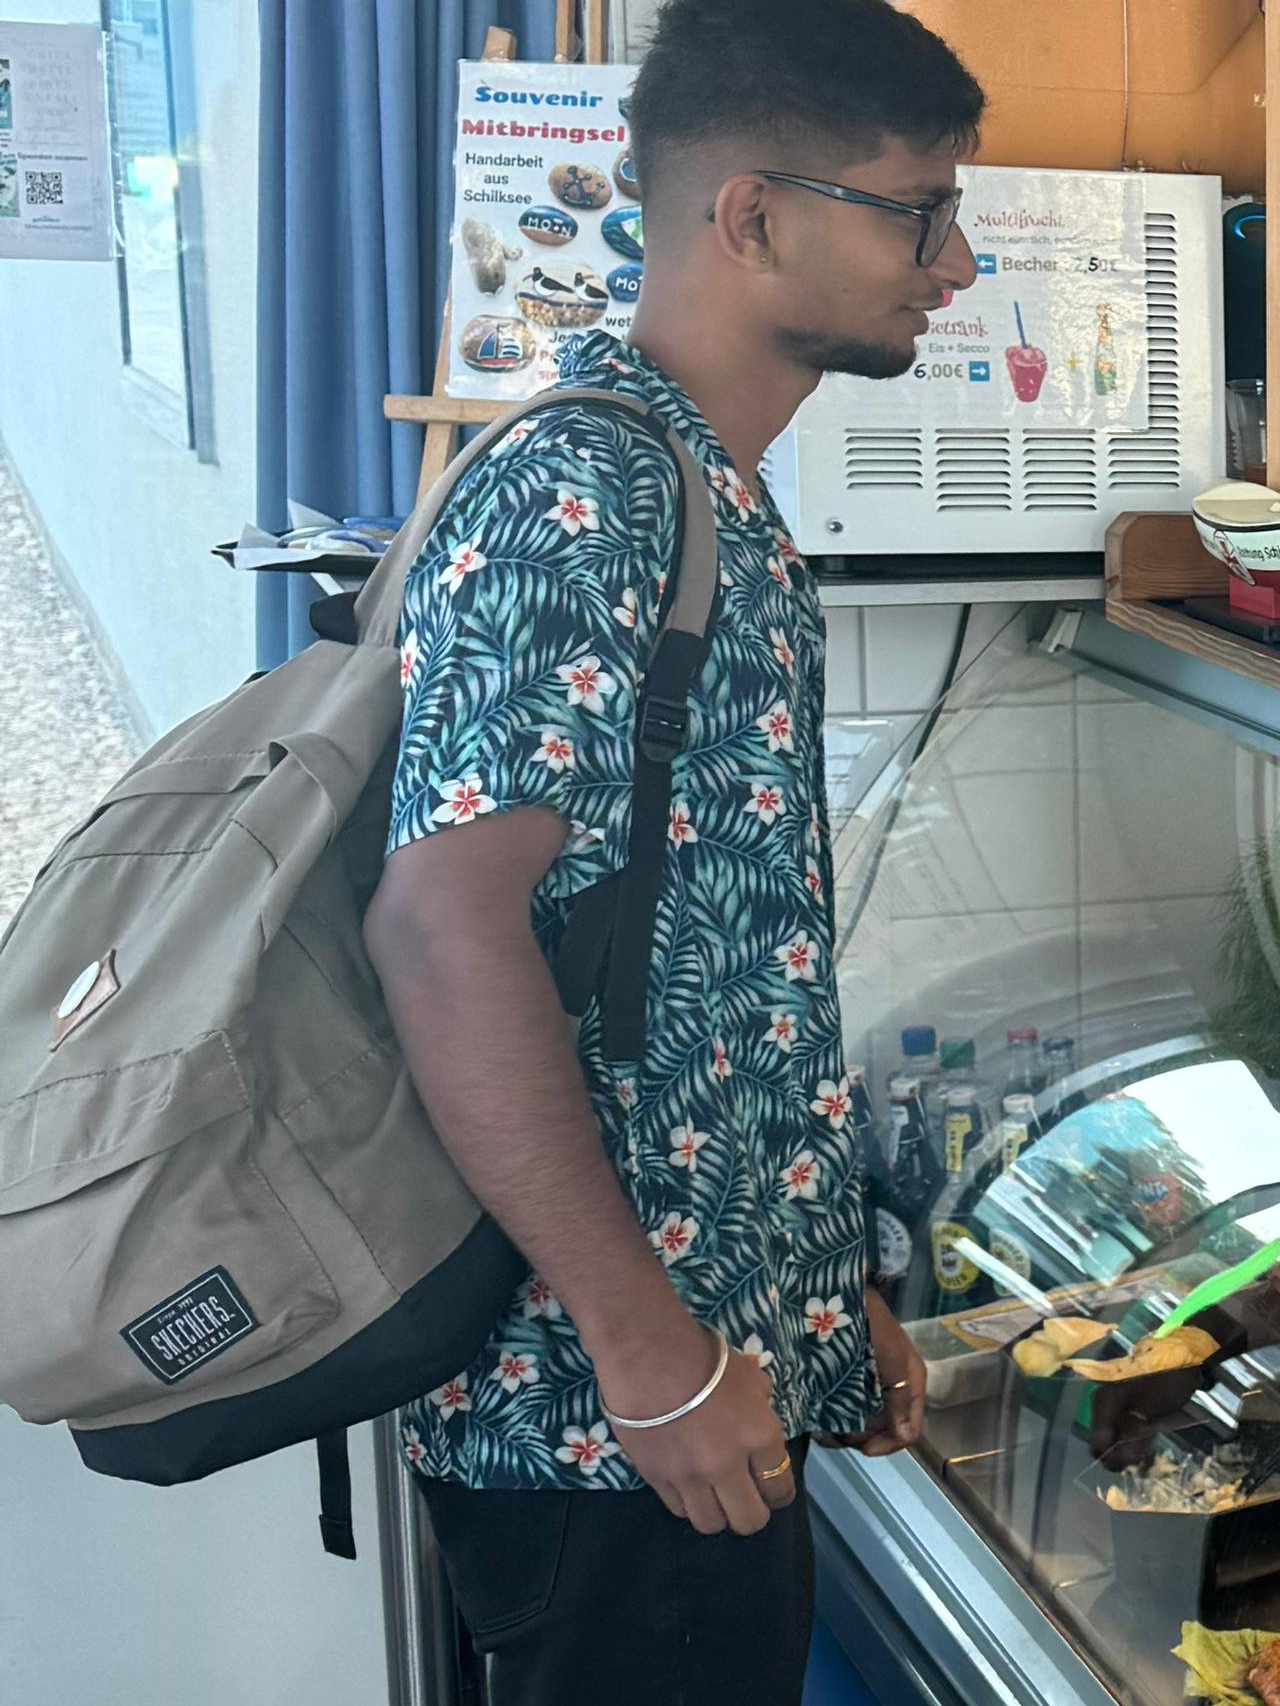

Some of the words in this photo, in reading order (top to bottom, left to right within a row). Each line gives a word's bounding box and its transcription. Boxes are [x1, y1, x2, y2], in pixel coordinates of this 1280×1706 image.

[475, 86, 603, 108] Souvenir
[462, 119, 625, 144] Mitbringsel
[465, 152, 544, 169] Handarbeit
[484, 172, 509, 185] aus
[463, 189, 532, 205] Schilksee
[1002, 256, 1057, 272] Becher
[956, 342, 990, 354] Secco
[913, 363, 964, 381] 6,00€
[150, 1295, 232, 1361] SKECHERS
